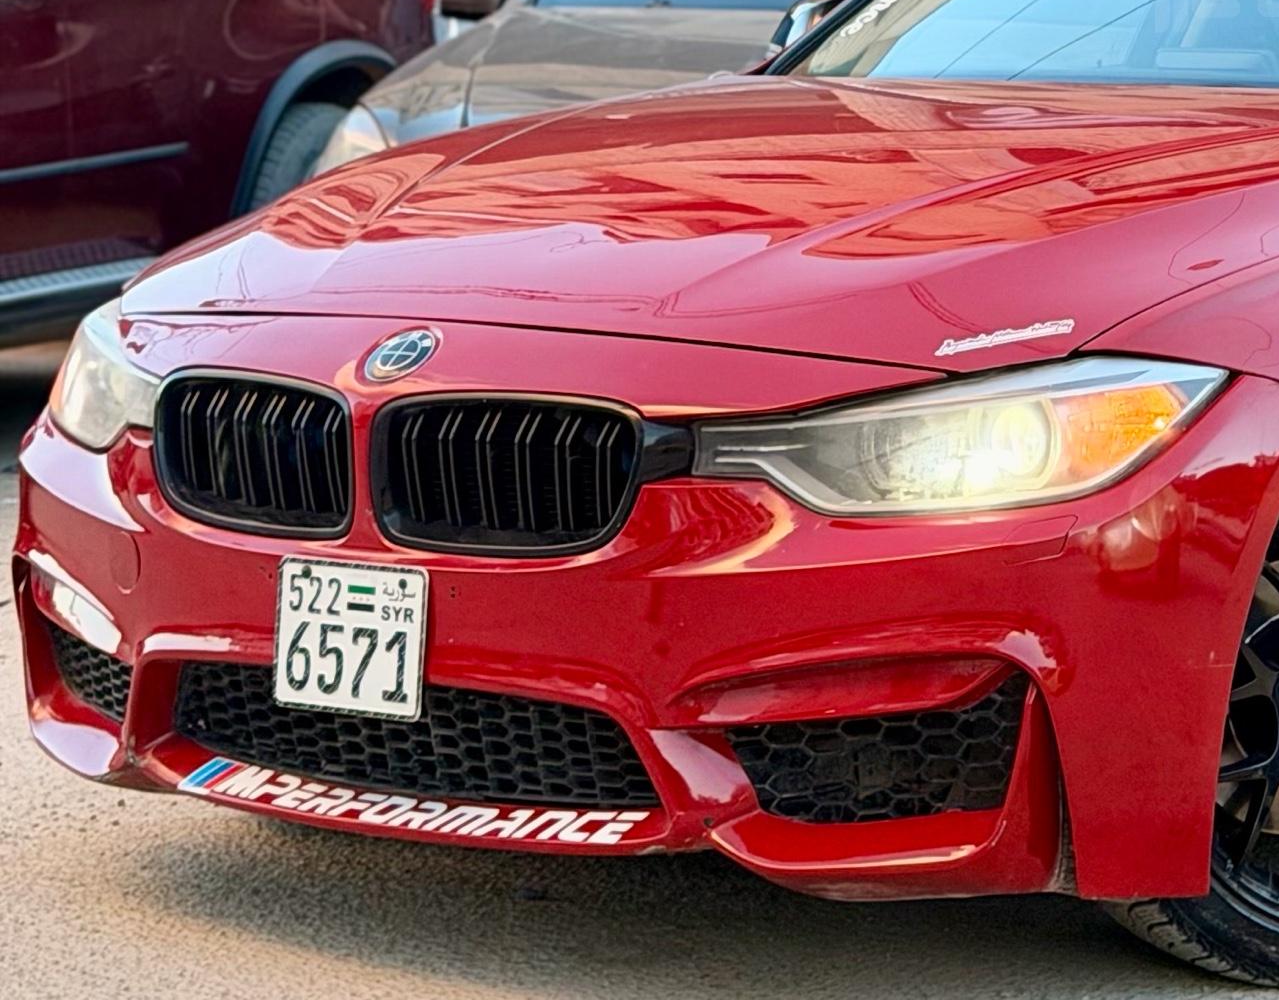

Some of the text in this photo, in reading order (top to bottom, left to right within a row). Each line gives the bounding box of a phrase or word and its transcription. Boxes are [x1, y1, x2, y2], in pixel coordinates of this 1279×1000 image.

[289, 573, 342, 616] 522
[380, 605, 415, 624] SYR
[286, 621, 409, 703] 6571
